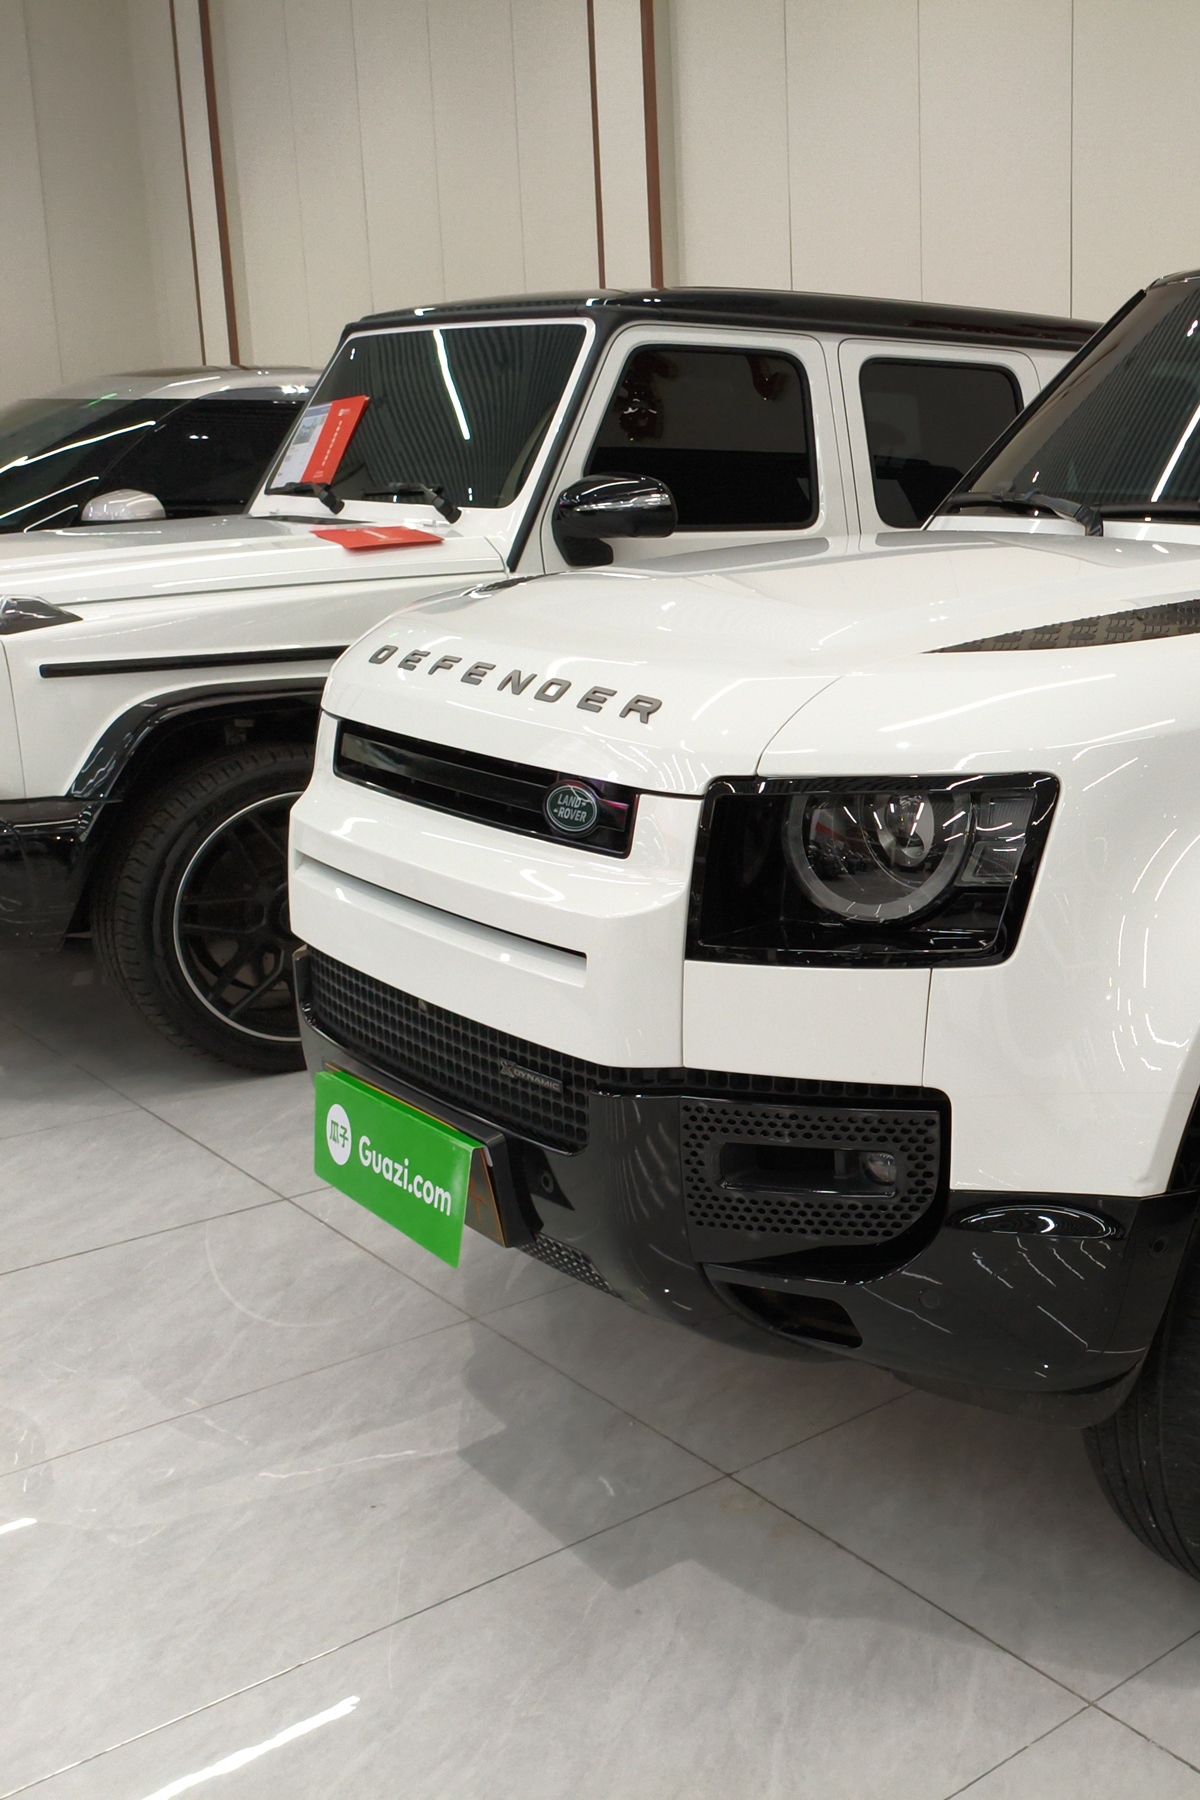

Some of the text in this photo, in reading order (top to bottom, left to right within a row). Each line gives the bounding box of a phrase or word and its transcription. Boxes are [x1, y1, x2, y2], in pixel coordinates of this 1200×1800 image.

[368, 644, 662, 724] DEFENDER
[329, 1119, 349, 1148] 瓜子
[358, 1135, 452, 1217] Guazi.com
